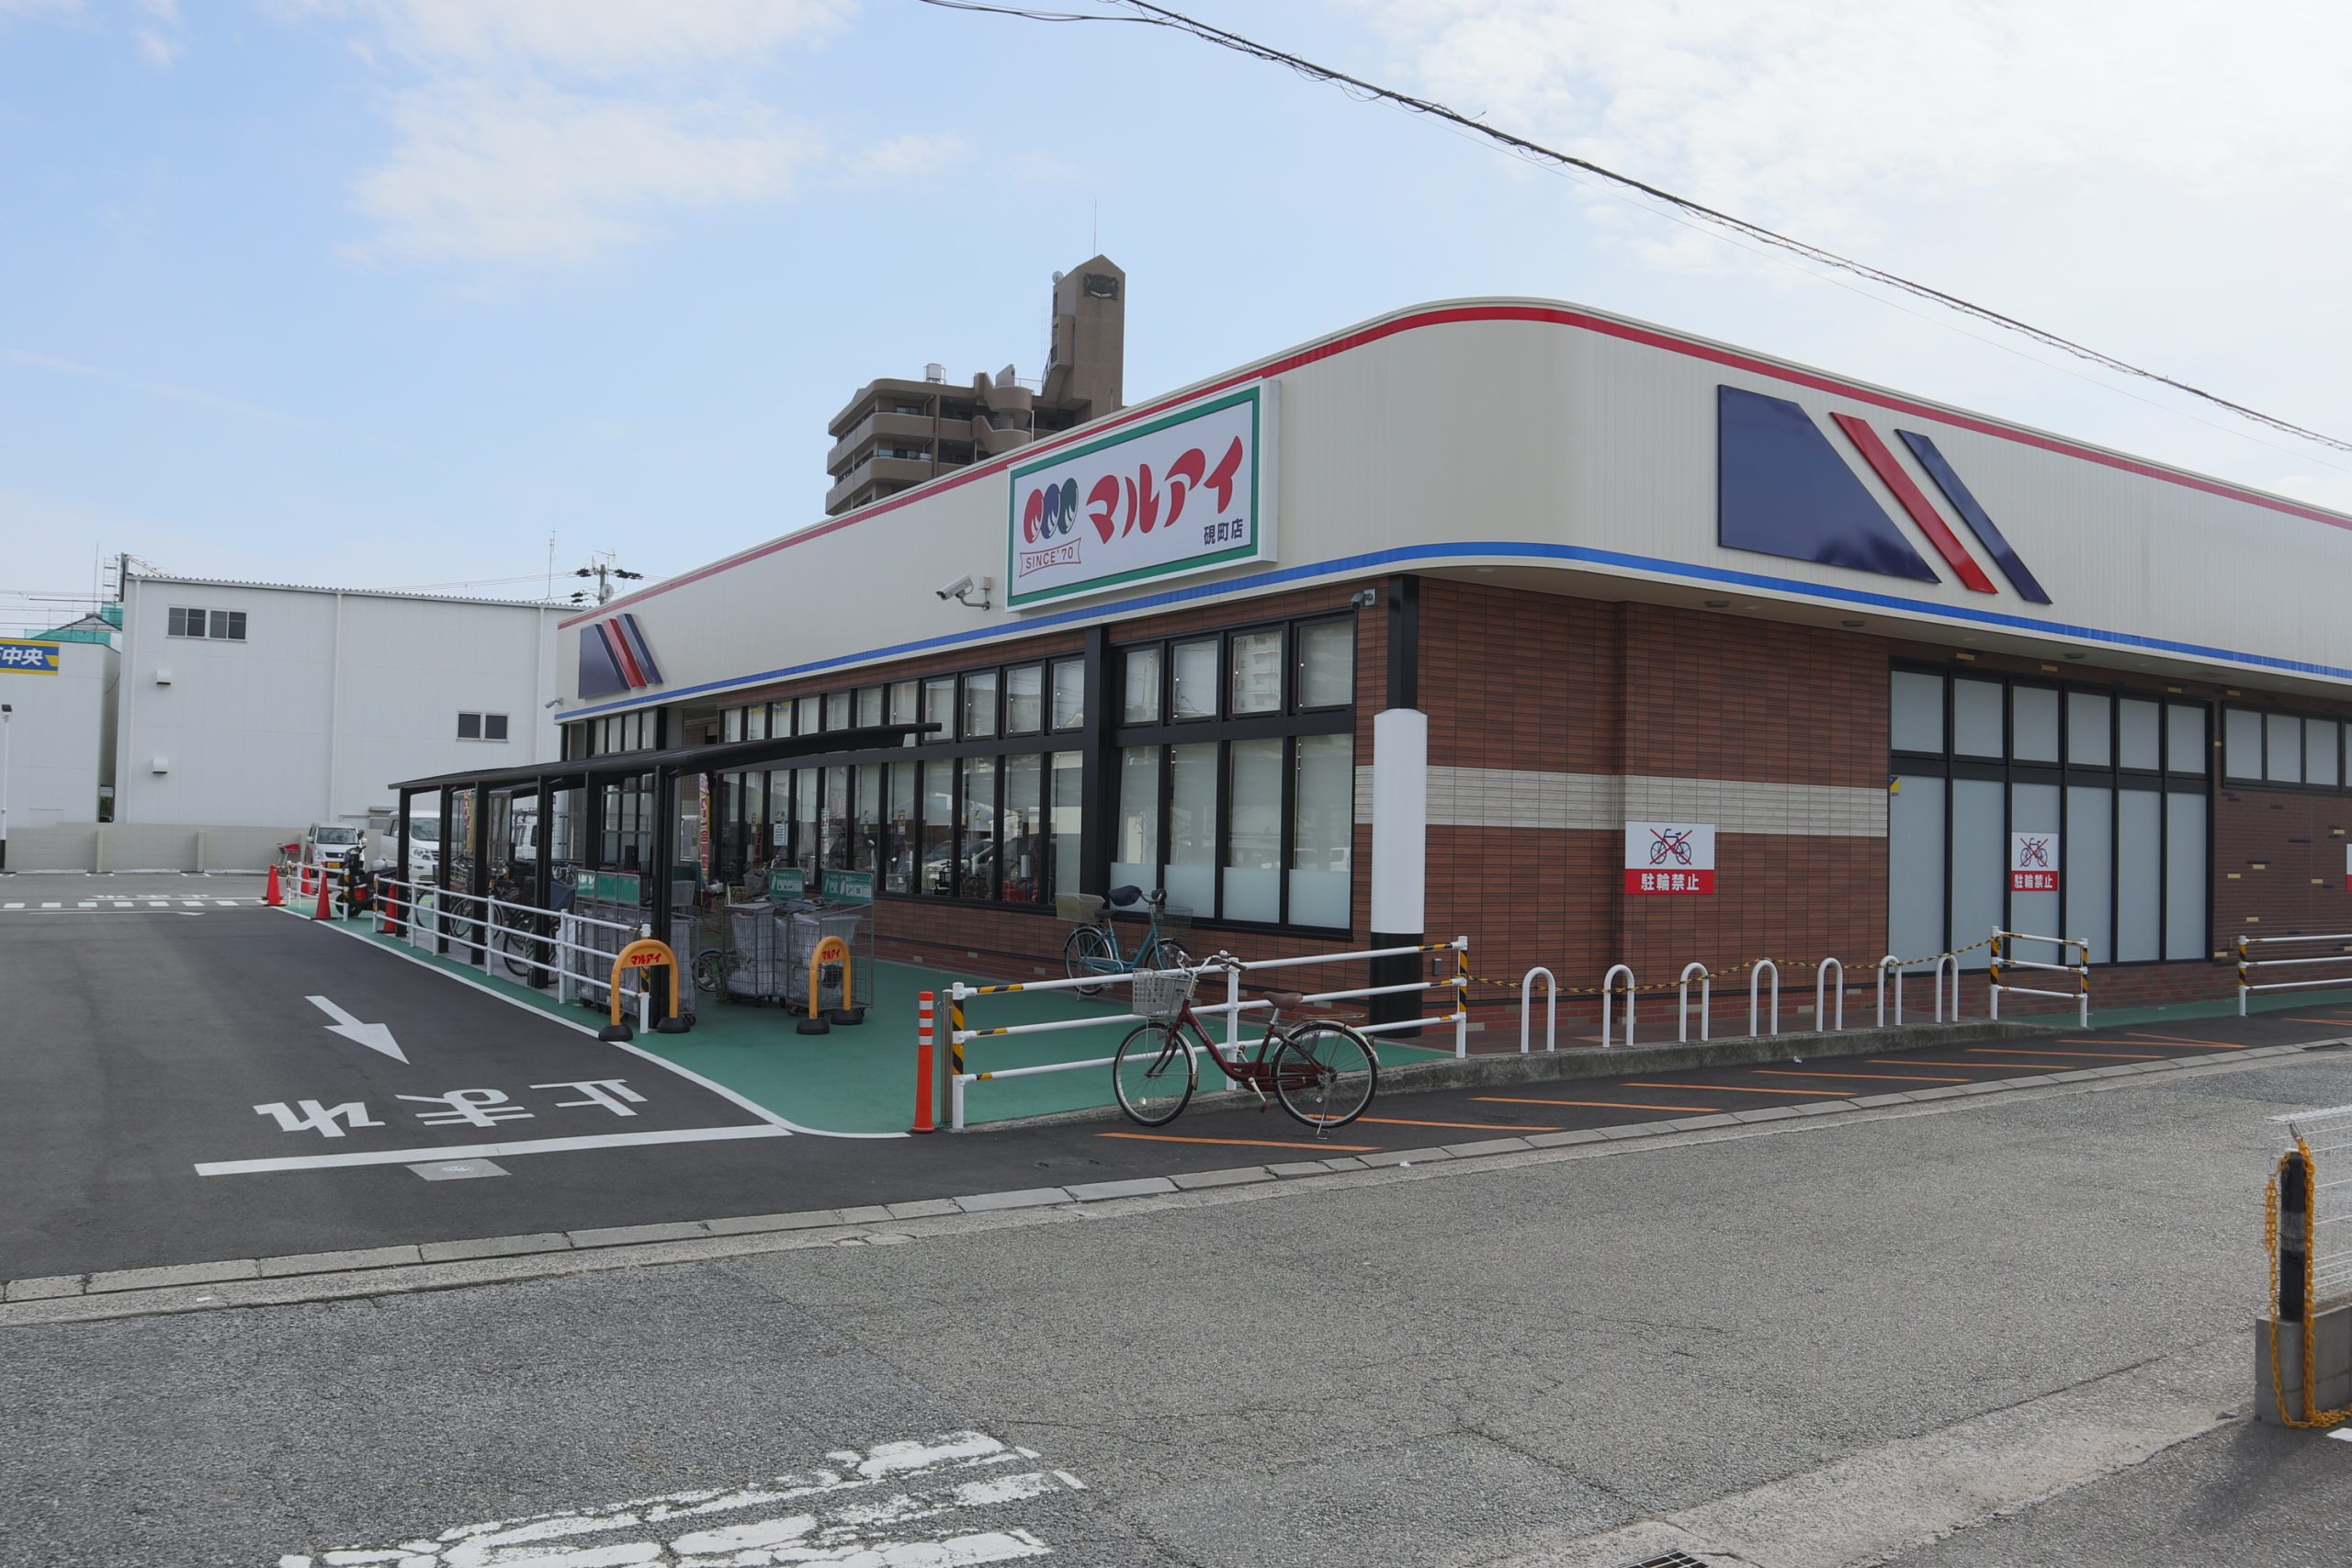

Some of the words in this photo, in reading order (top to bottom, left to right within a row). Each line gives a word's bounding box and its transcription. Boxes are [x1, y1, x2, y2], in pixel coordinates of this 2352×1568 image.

[1086, 435, 1243, 545] マルアイ
[1204, 518, 1244, 546] 硯町店
[0, 646, 43, 666] 中央
[1640, 873, 1700, 891] 駐輪禁止
[2014, 874, 2053, 888] 駐輪禁止
[630, 953, 662, 965] マルアイ
[253, 1078, 649, 1138] 止まれ
